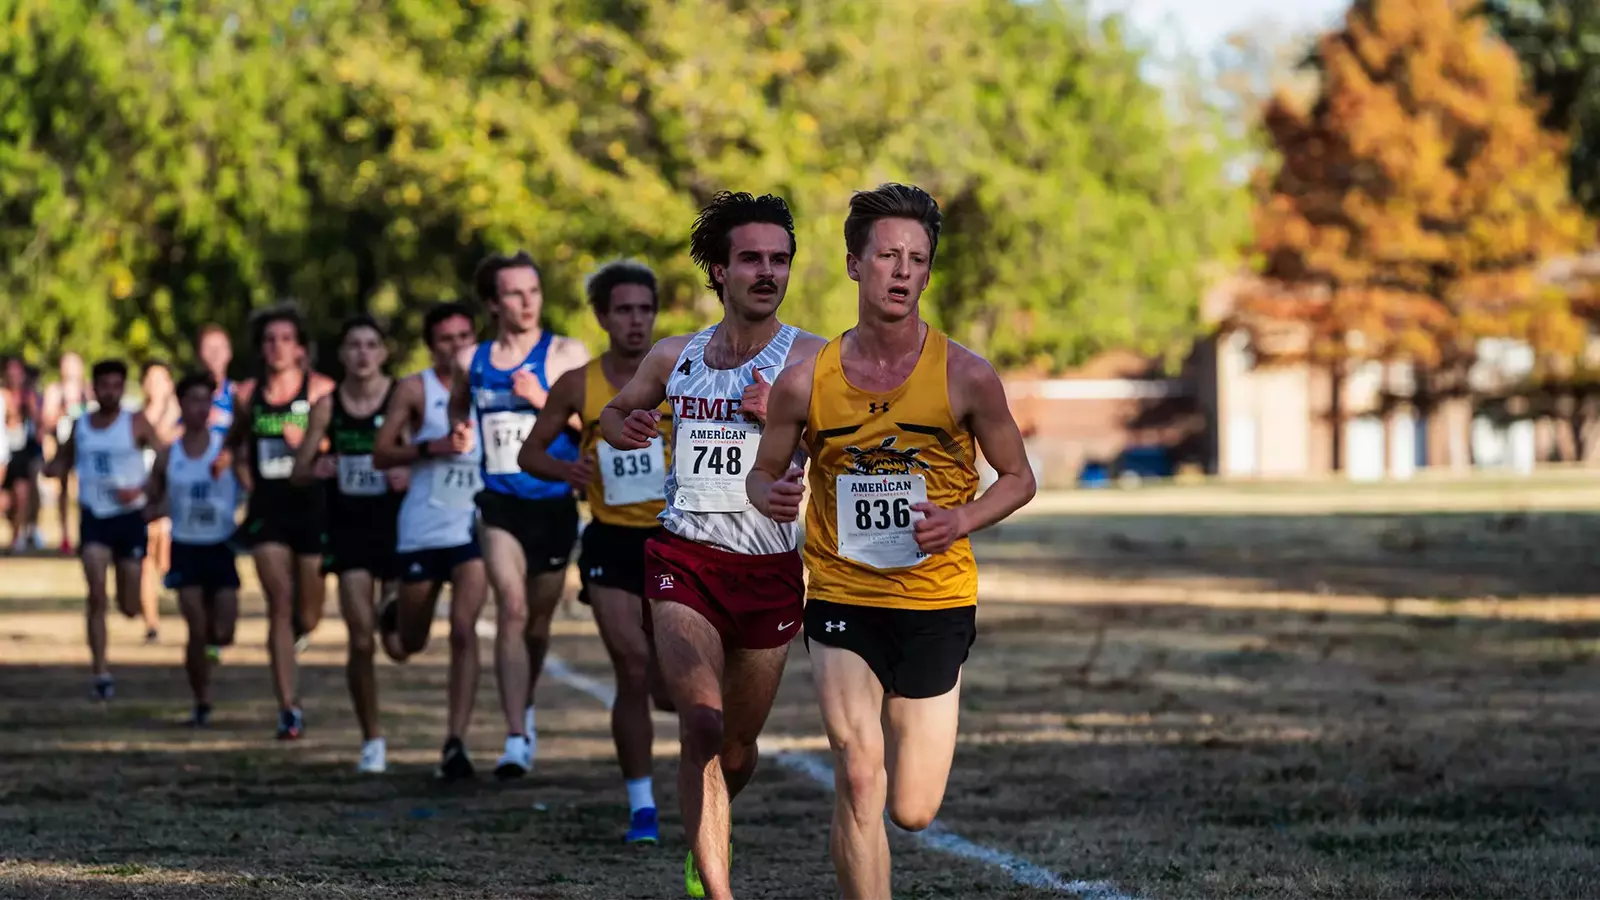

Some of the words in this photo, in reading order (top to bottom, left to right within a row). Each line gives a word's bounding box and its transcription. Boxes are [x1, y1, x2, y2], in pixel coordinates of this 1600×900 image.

[689, 429, 747, 440] AMERICAN
[613, 453, 652, 477] 839
[693, 446, 741, 476] 748
[850, 481, 912, 492] AMERICAN
[855, 498, 910, 530] 836
